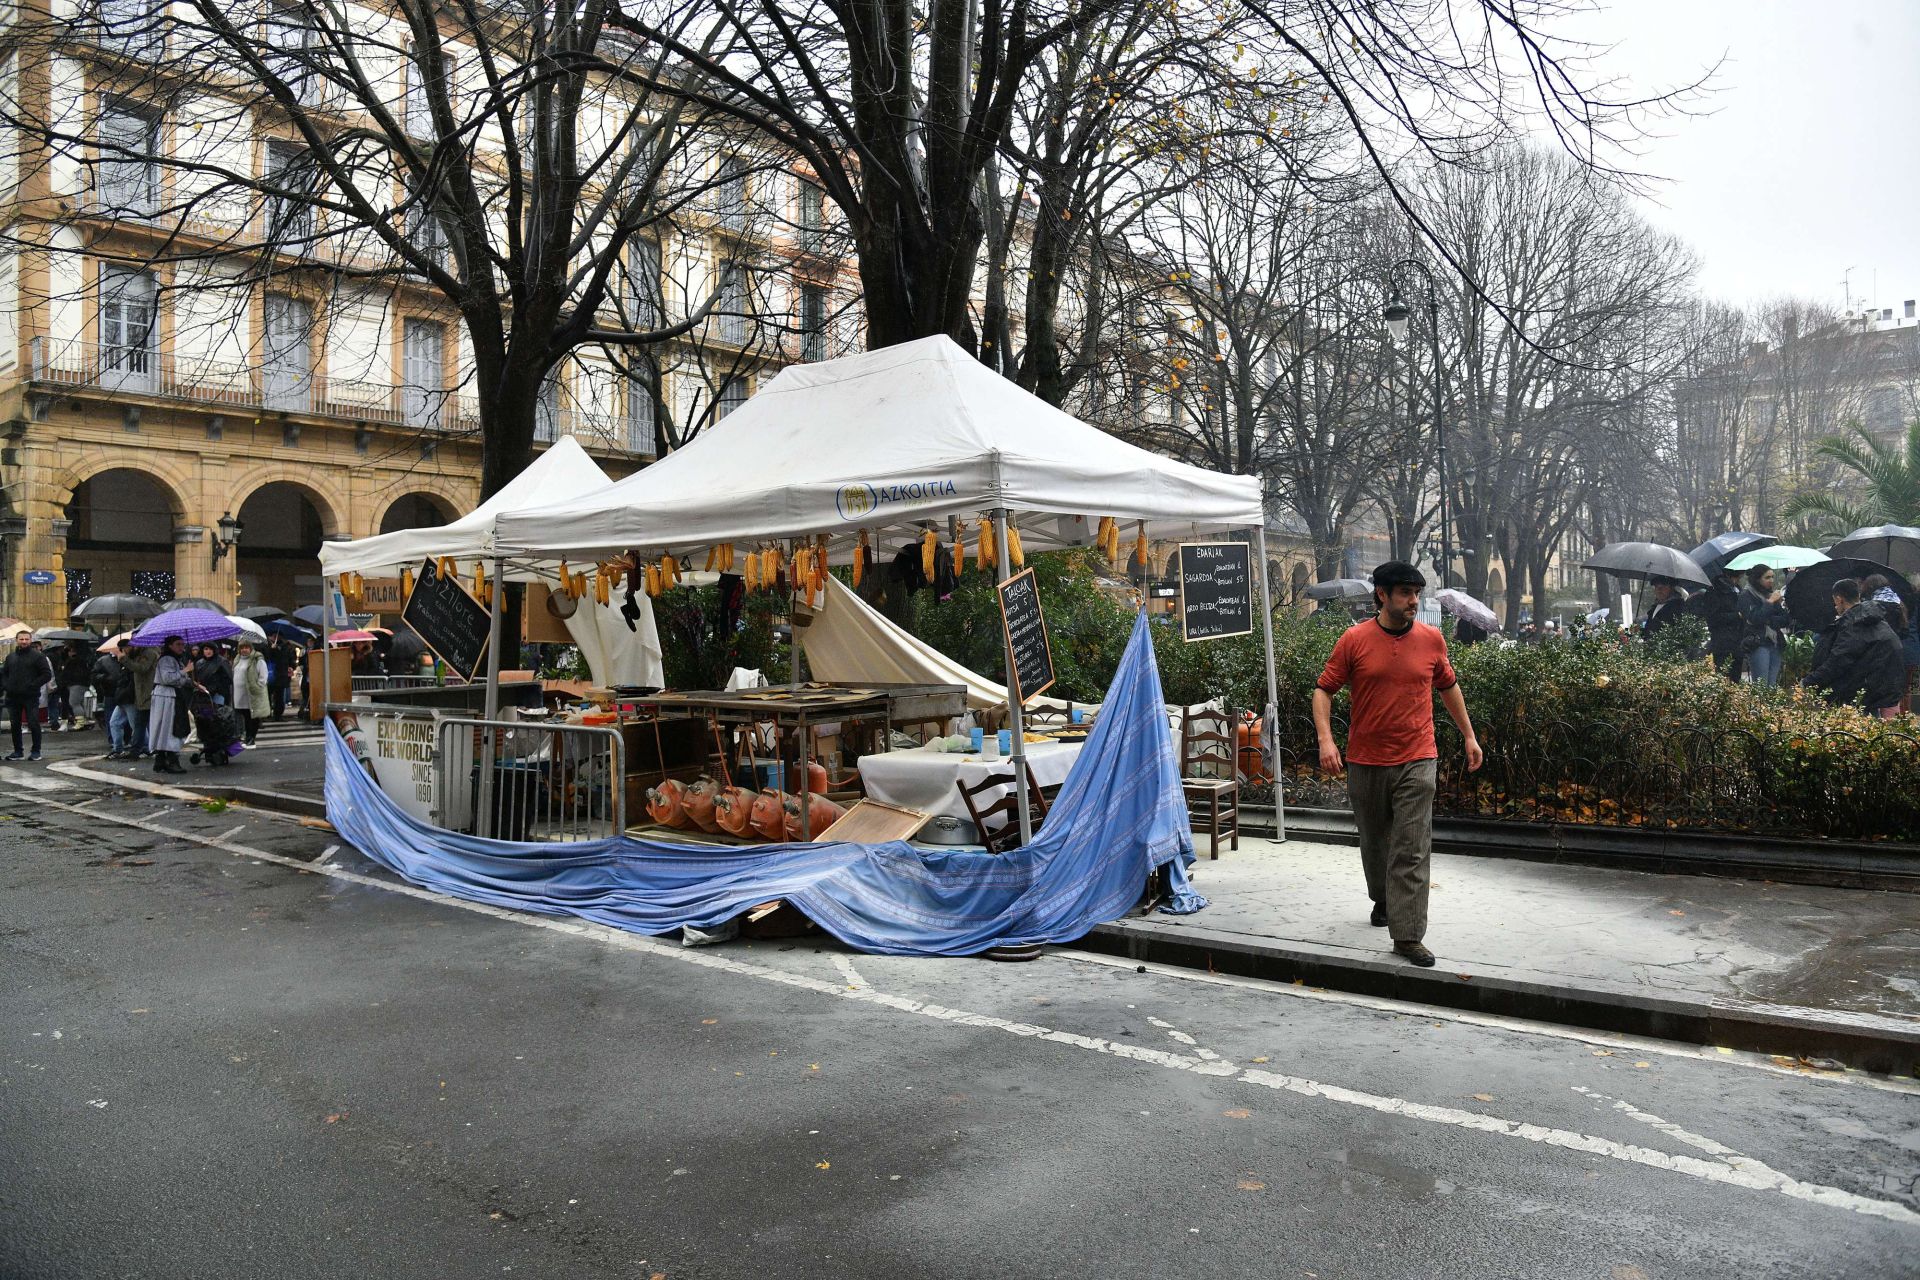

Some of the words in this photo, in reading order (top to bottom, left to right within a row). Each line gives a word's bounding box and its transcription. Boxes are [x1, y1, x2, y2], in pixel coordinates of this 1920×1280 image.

[881, 480, 957, 503] AZKOITIA
[1184, 573, 1213, 584] SAGARDOA
[364, 585, 398, 602] TALOAK
[1004, 579, 1032, 600] TALOAK
[1186, 604, 1199, 614] ARDO
[377, 721, 434, 744] EXPLORING
[376, 740, 395, 758] THE
[396, 742, 433, 763] WORLD
[411, 763, 432, 783] SINCE
[416, 784, 432, 803] 1890
